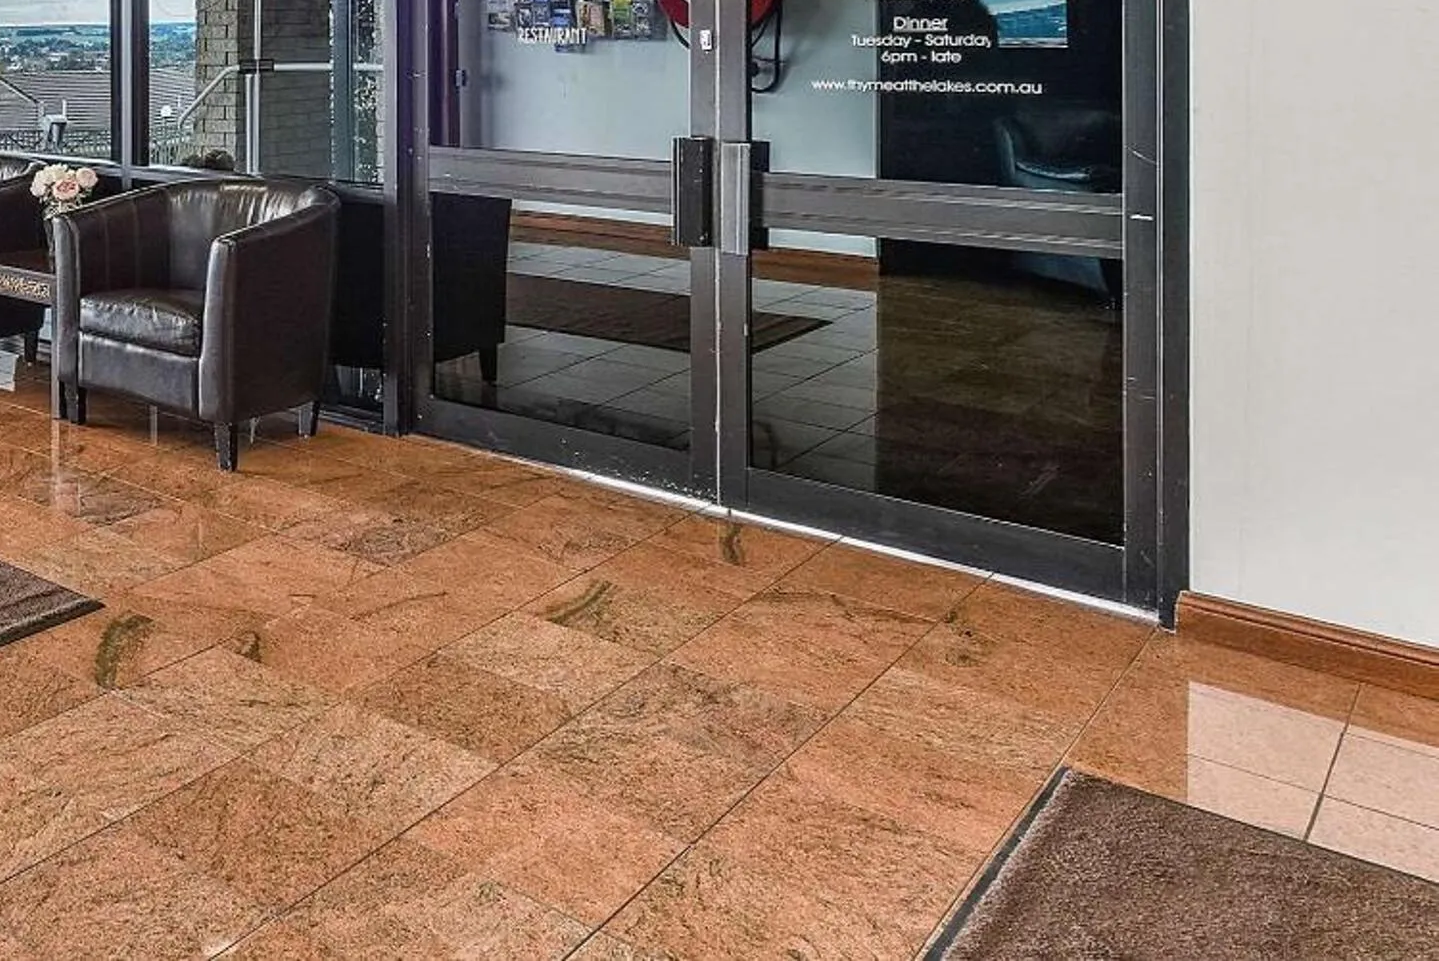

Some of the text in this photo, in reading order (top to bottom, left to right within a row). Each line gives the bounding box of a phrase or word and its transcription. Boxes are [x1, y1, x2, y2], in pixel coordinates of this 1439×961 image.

[893, 16, 948, 32] Dinner
[517, 27, 587, 45] RESTAURANT
[851, 34, 911, 48] Tuesday
[924, 33, 992, 48] Saturday
[881, 51, 918, 64] 6pm
[931, 50, 962, 63] late
[811, 79, 1042, 94] www.thymeatthelakes.com.au
